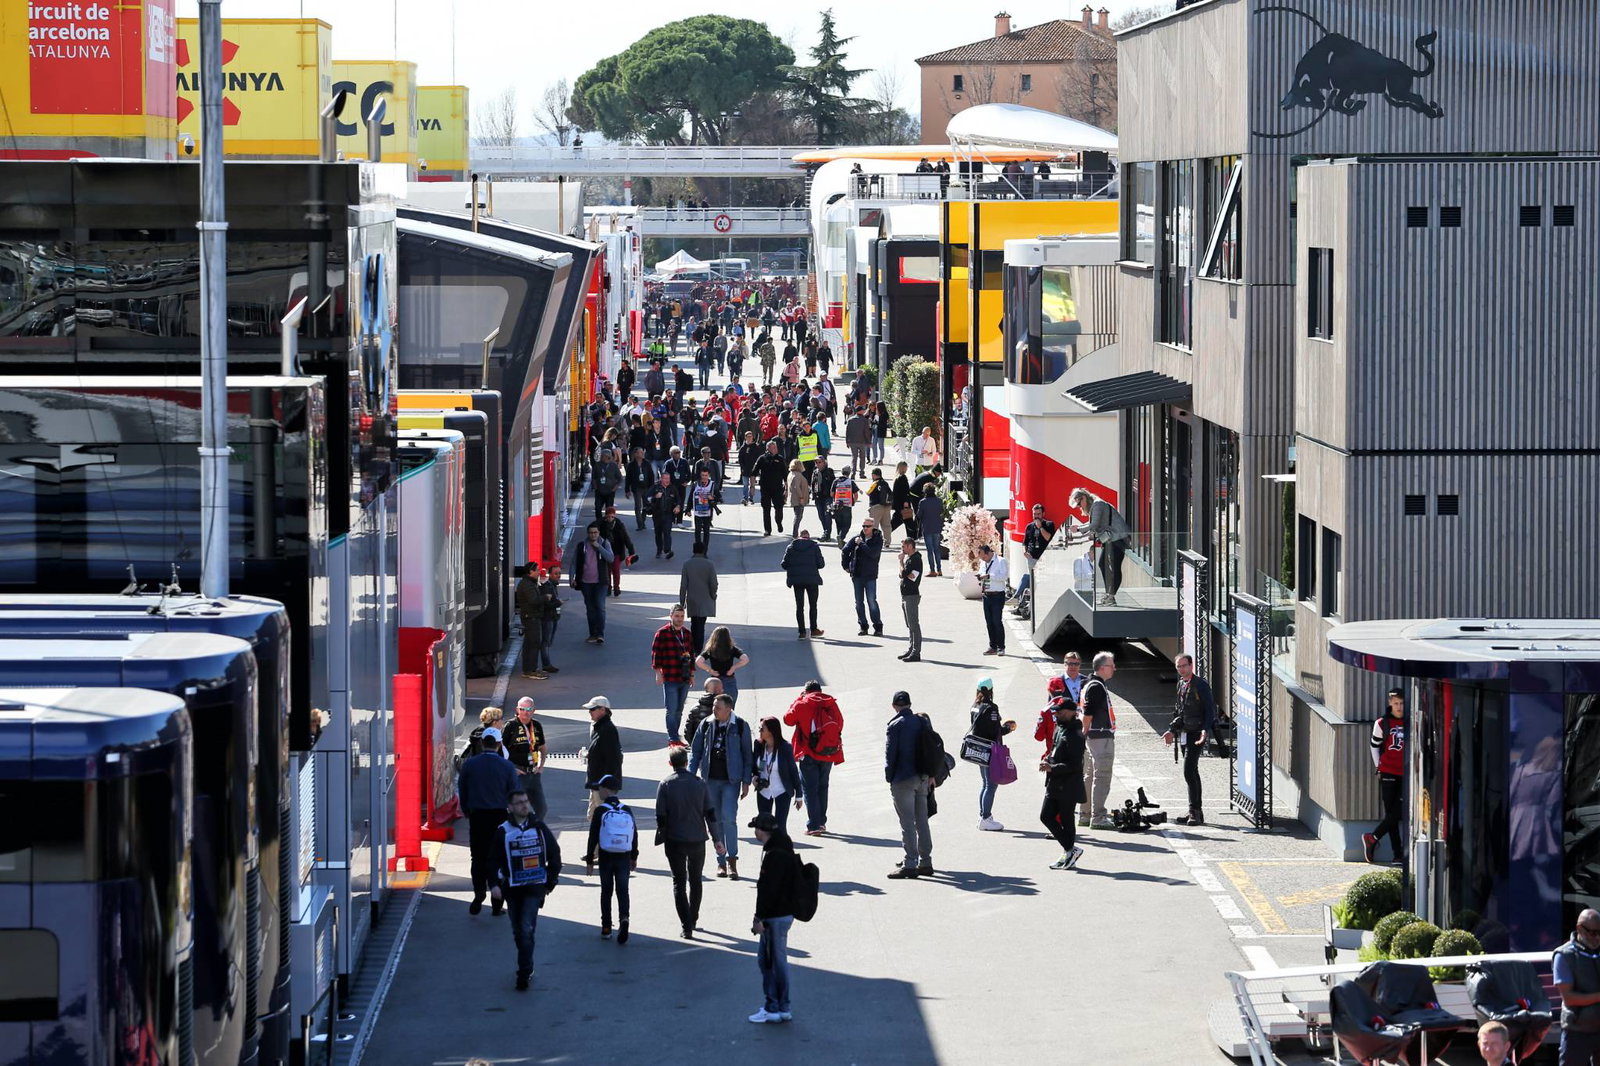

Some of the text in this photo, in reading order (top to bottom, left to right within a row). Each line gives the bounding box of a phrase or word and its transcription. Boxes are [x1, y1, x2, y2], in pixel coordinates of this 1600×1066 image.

[29, 2, 110, 20] ircuit de
[29, 23, 110, 40] arcelona
[28, 45, 111, 59] ATALUNYA
[416, 118, 442, 131] YA
